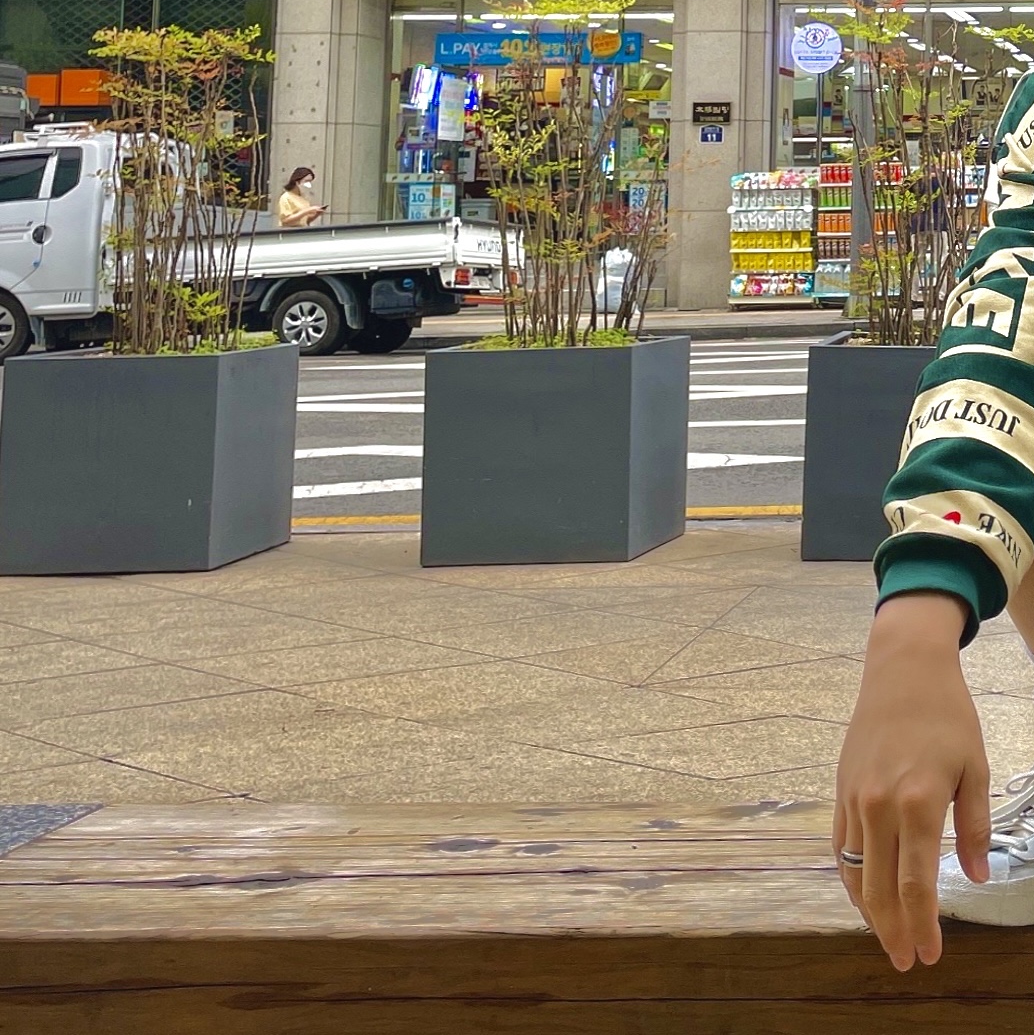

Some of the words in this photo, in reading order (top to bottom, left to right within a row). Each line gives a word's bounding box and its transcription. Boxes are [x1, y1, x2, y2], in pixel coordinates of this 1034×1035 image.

[707, 134, 716, 142] 11
[954, 399, 1020, 438] JUST
[976, 512, 1022, 568] NIKE
